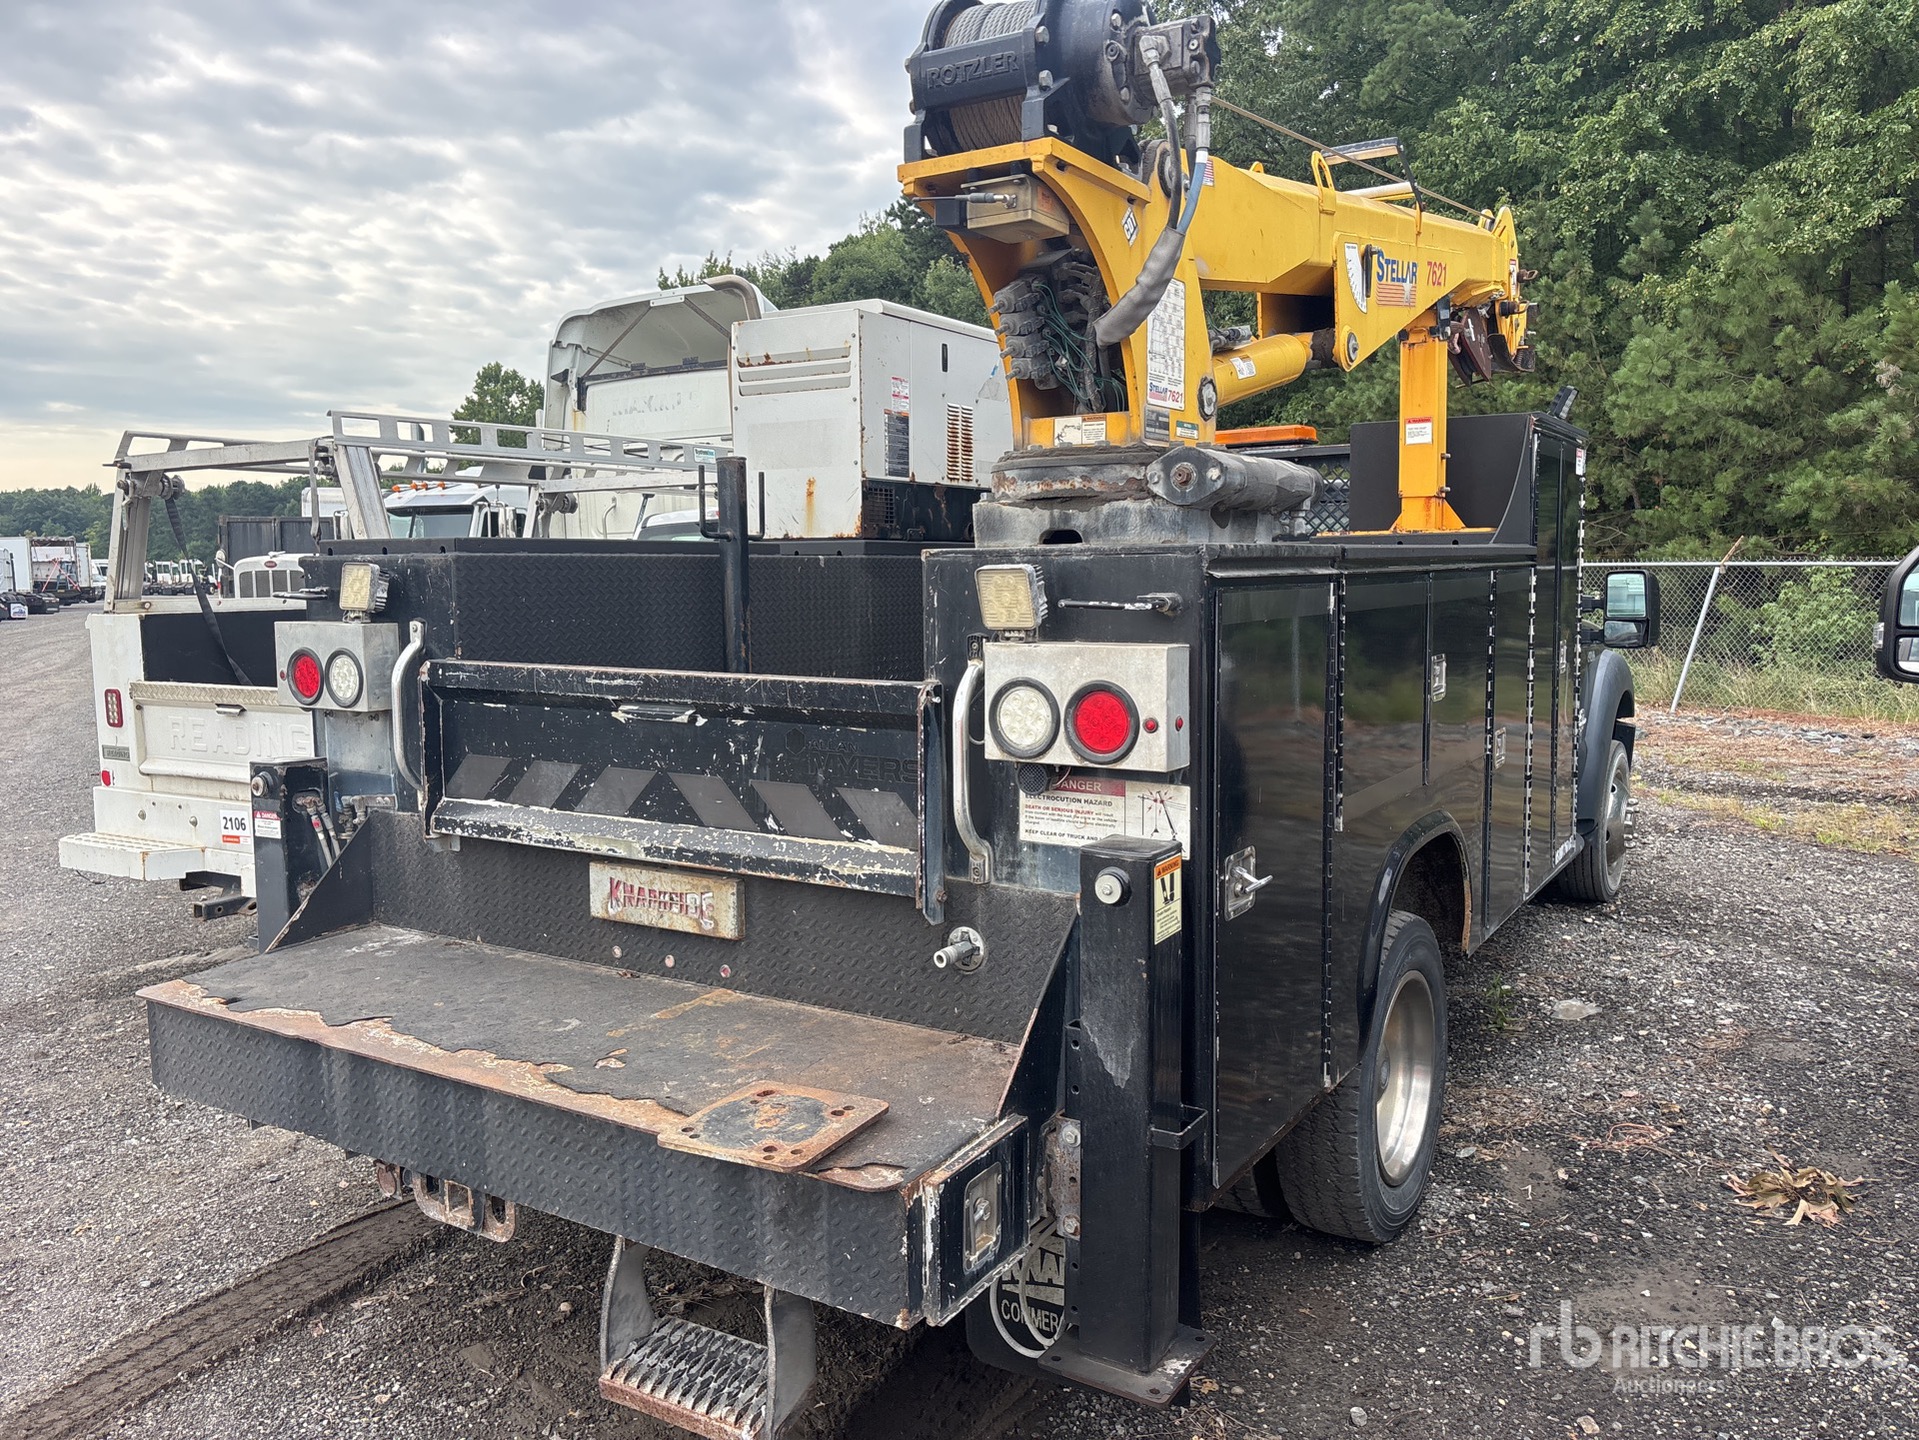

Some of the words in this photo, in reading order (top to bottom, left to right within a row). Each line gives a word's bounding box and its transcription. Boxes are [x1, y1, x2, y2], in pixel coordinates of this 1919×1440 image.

[926, 51, 1019, 89] ROTZLER
[1376, 249, 1418, 284] STELLAR
[1427, 261, 1447, 286] 7621
[1149, 382, 1168, 395] STELLAR
[1168, 389, 1183, 404] 7621
[168, 714, 311, 758] READING
[1060, 779, 1102, 792] ANGER
[1051, 806, 1074, 814] SERIOUS
[1083, 798, 1113, 807] HAZARD
[222, 816, 247, 831] 2106
